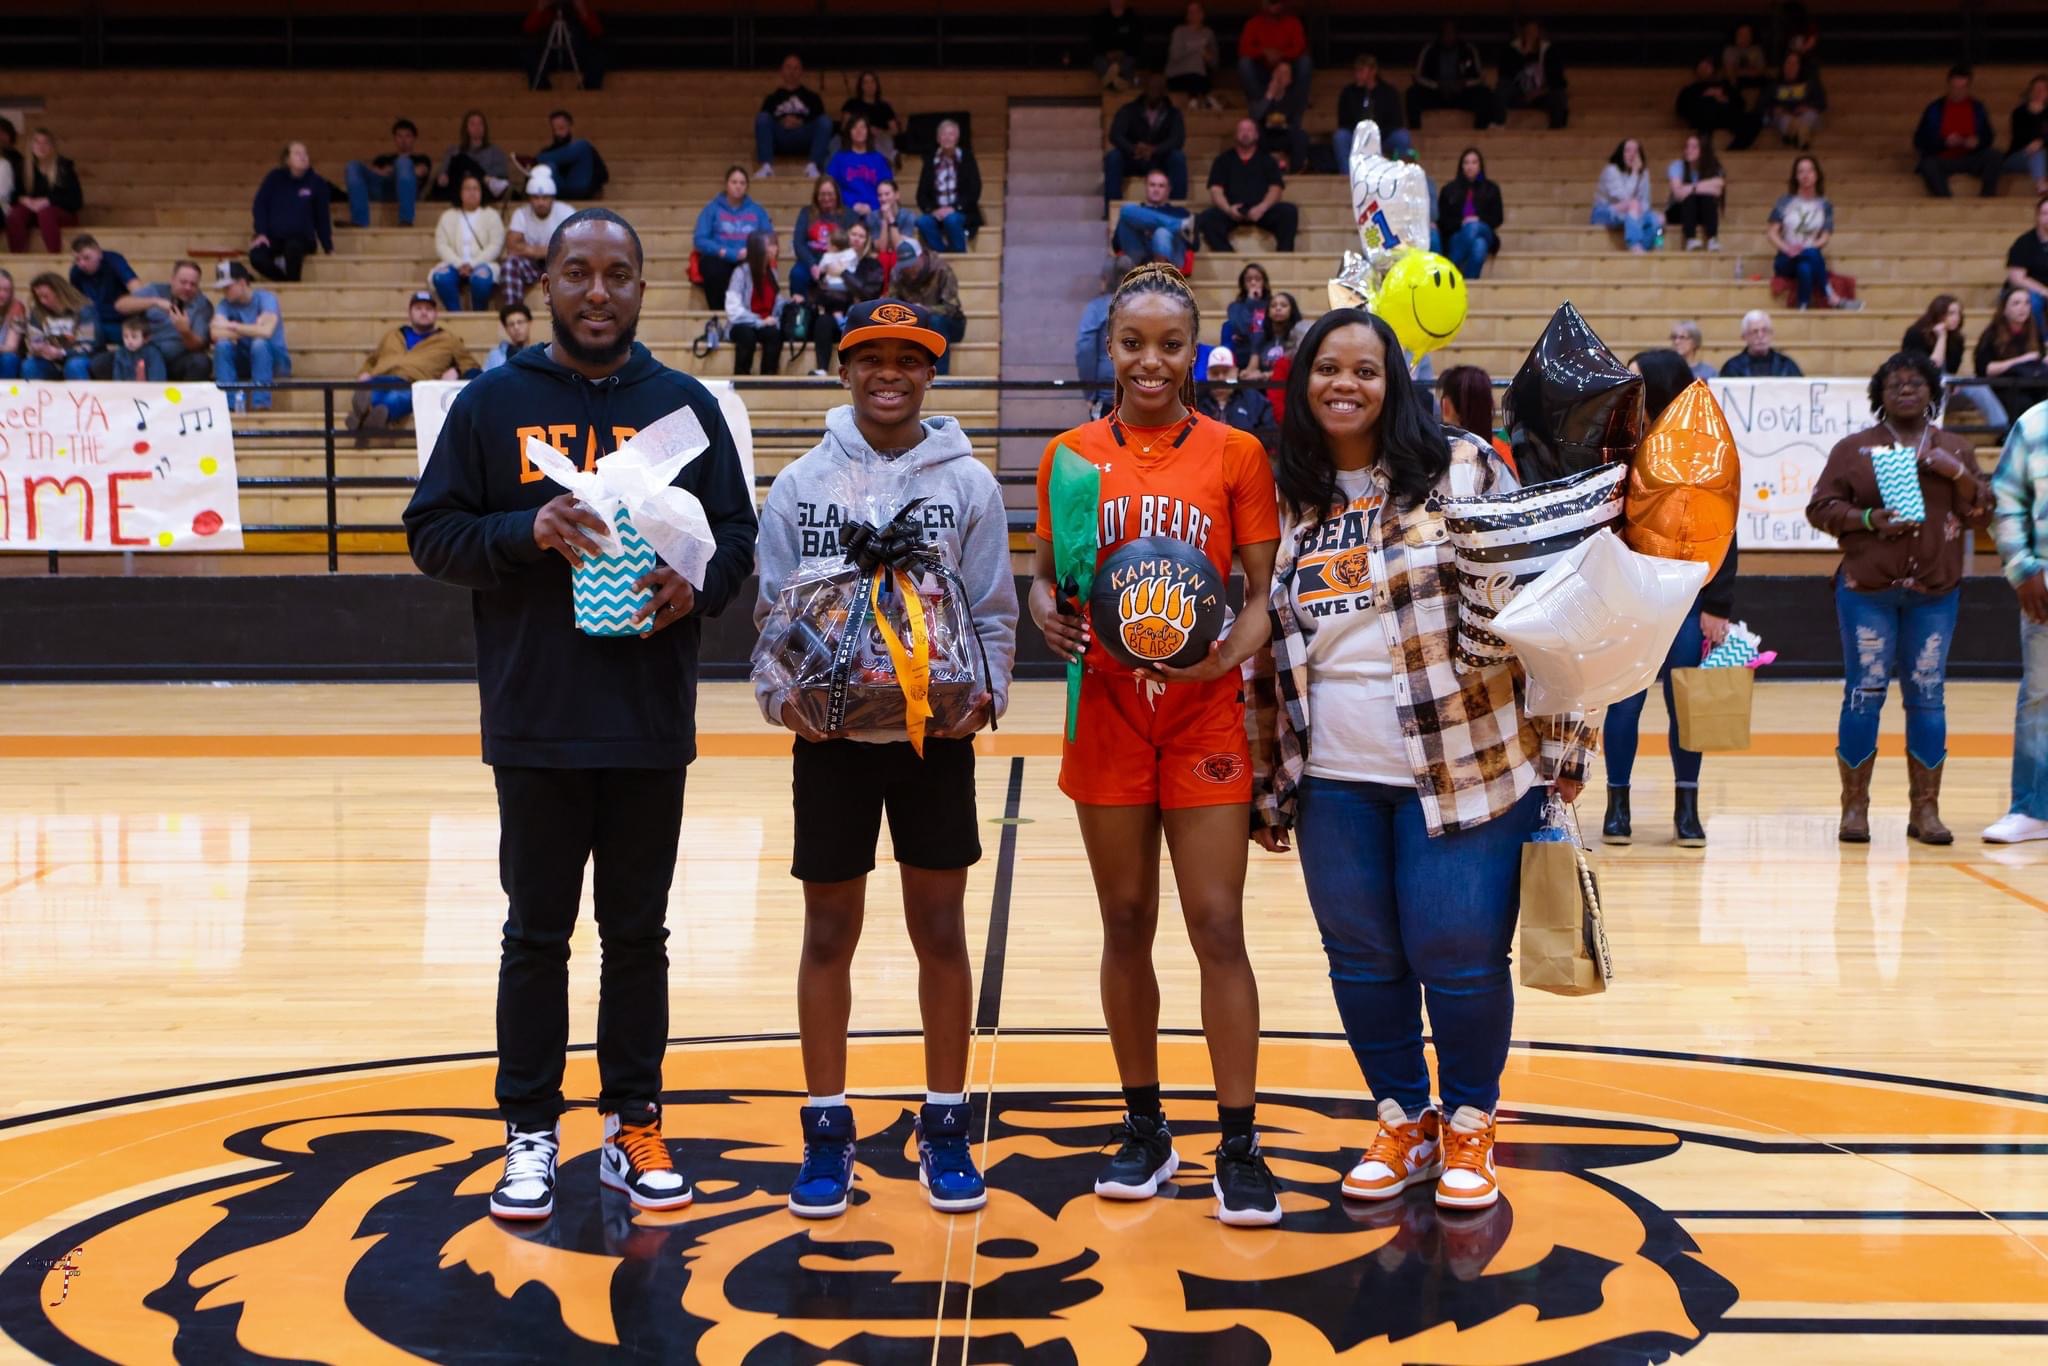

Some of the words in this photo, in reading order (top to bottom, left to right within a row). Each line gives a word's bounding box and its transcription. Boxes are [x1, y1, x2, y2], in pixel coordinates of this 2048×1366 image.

[68, 390, 109, 431] YA
[1139, 495, 1212, 556] BEARS
[1111, 560, 1206, 591] KAMRYN
[1355, 595, 1376, 611] C
